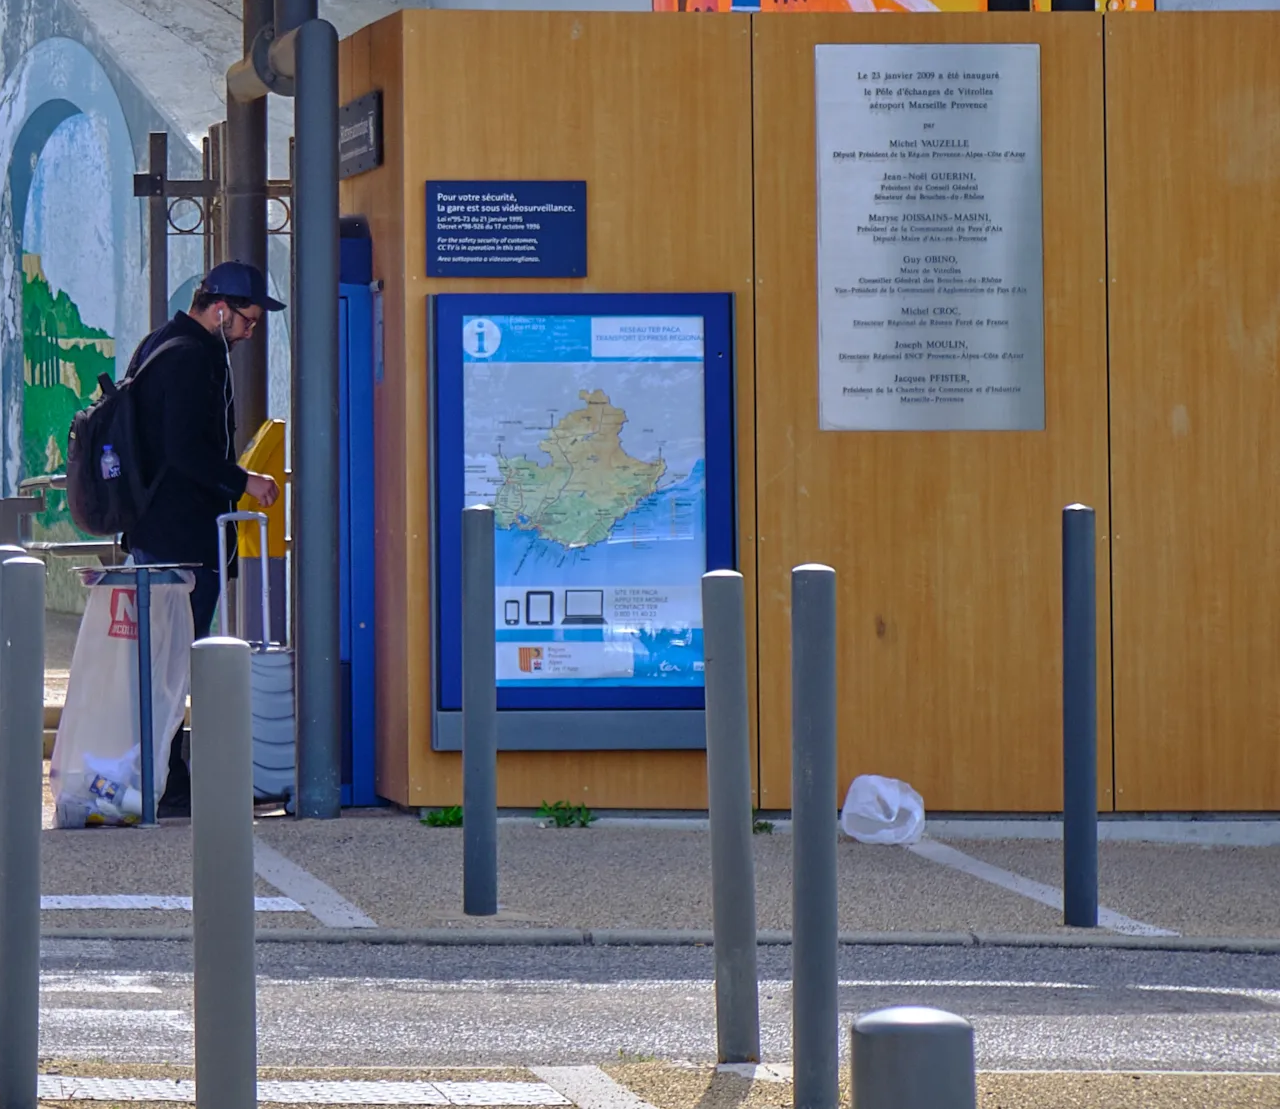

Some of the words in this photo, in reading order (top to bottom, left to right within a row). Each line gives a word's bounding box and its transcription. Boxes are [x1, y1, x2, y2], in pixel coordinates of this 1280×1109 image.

[438, 193, 456, 202] Pour
[458, 194, 480, 202] votre
[482, 193, 517, 202] sécurité,
[447, 205, 465, 213] gare
[502, 204, 576, 212] vidéosurveillance.
